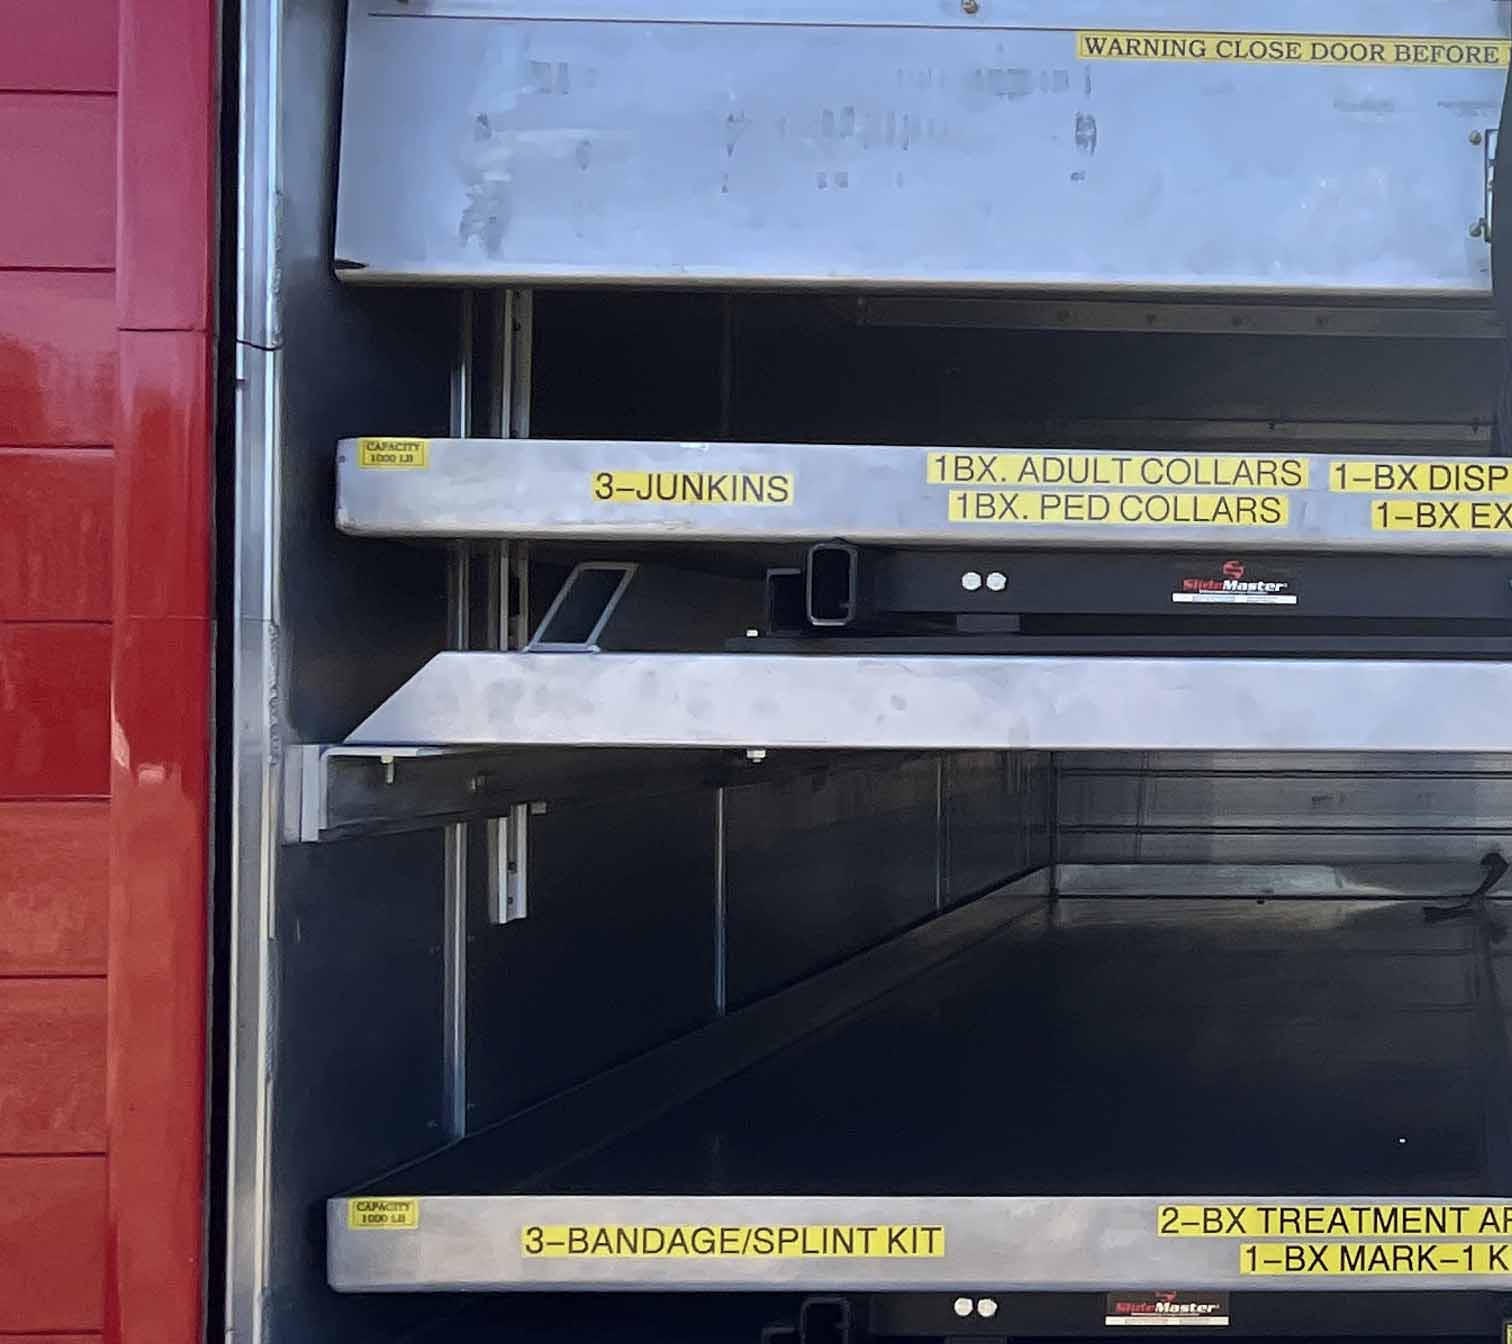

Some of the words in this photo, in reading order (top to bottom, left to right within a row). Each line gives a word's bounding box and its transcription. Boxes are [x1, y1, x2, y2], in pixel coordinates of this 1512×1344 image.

[1084, 37, 1206, 58] WARNING
[1215, 40, 1301, 60] CLOSE
[1310, 42, 1386, 62] DOOR
[1395, 44, 1499, 64] BEFORE
[366, 441, 420, 452] CAPACITY
[935, 455, 1007, 482] 1BX.
[1018, 457, 1132, 484] ADULT
[1141, 458, 1302, 487] COLLARS
[1335, 463, 1418, 491] 1-BX
[1429, 464, 1509, 492] DISP
[595, 472, 789, 503] 3-JUNKINS
[957, 493, 1029, 520] 1BX.
[1040, 494, 1110, 521] PED
[1120, 494, 1281, 524] COLLARS
[1377, 502, 1460, 529] 1-BX
[356, 1201, 409, 1212] CAPACITY
[1161, 1208, 1247, 1234] 2-BX
[1257, 1207, 1470, 1234] TREATMENT
[525, 1227, 877, 1255] 3-BANDAGE/SPLINT
[888, 1227, 942, 1254] KIT
[1246, 1245, 1330, 1272] 1-BX
[1340, 1245, 1473, 1272] MARK-1
